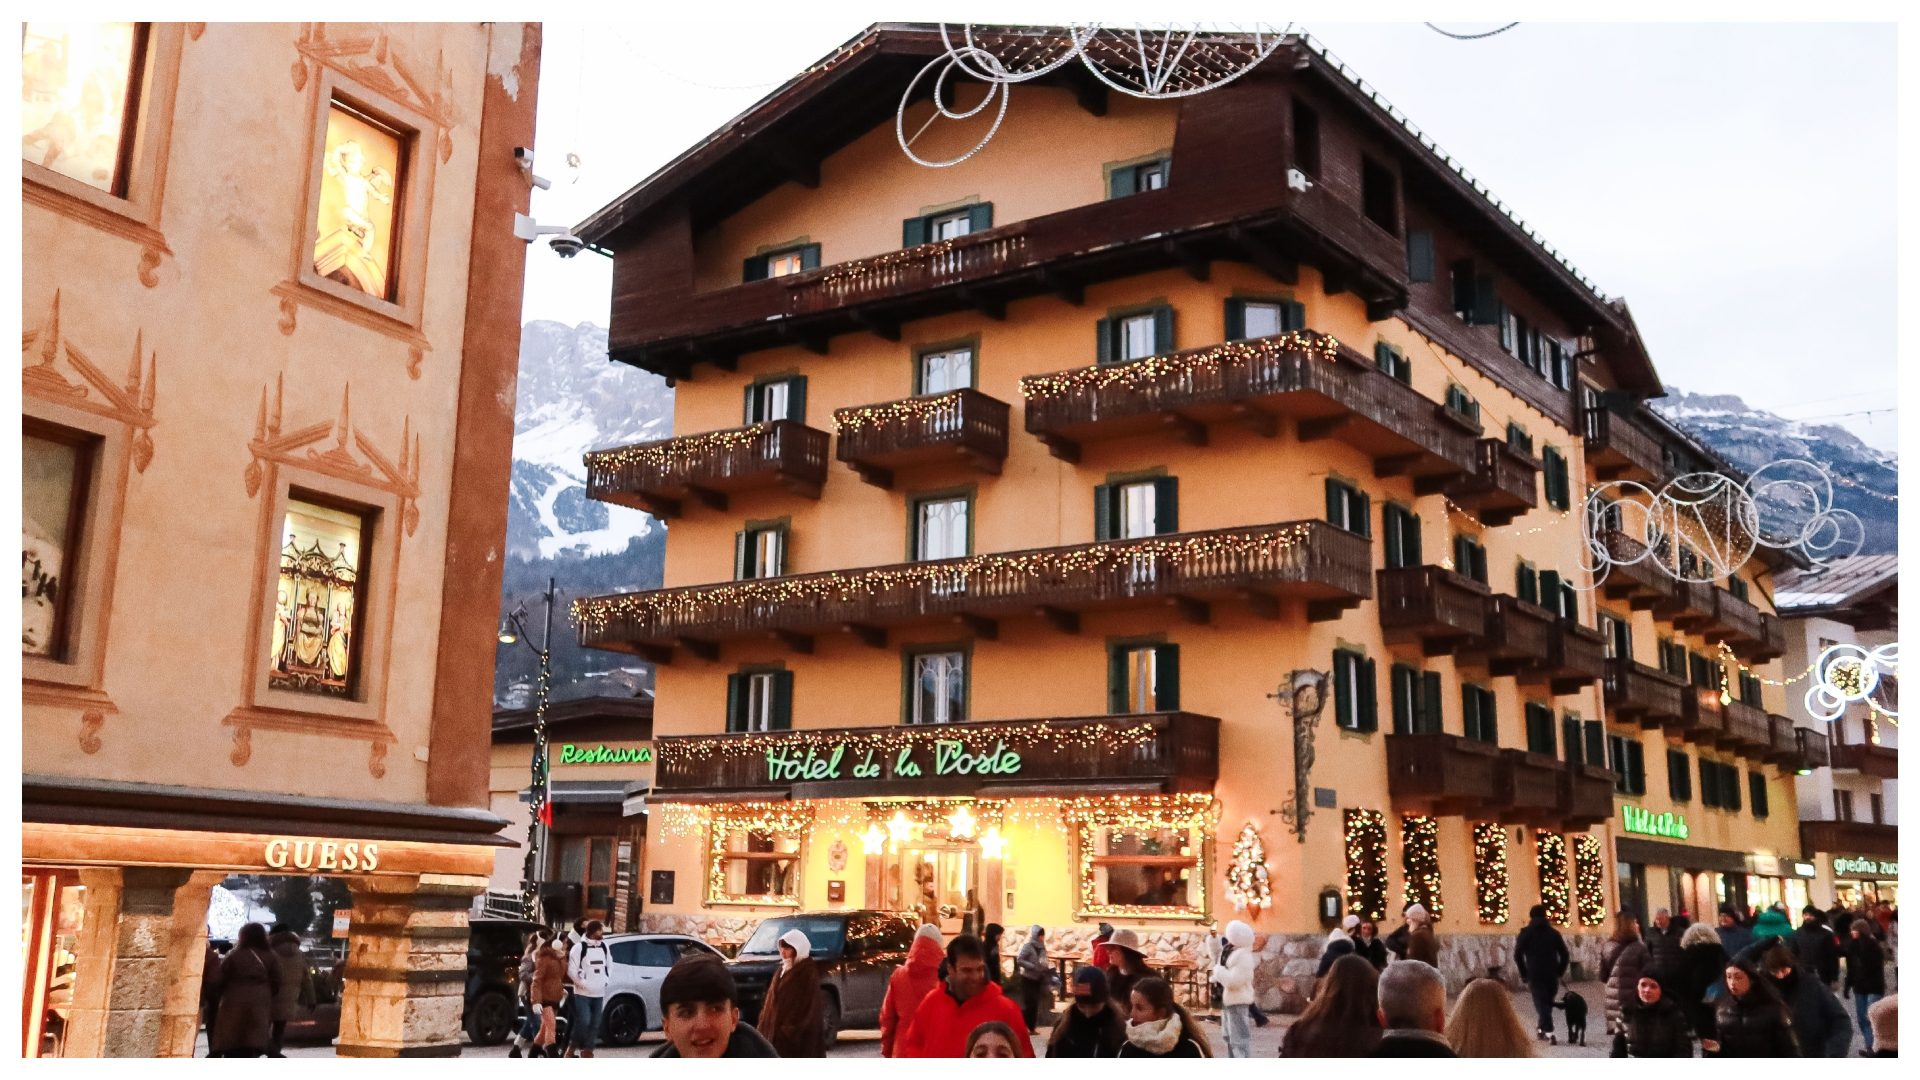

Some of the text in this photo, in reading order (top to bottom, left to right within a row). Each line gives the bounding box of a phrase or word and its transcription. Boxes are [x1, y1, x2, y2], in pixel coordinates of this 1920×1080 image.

[853, 749, 880, 778] de
[894, 747, 922, 776] la
[935, 739, 1022, 775] Poste
[265, 839, 378, 871] GUESS
[1834, 857, 1876, 876] ghedina
